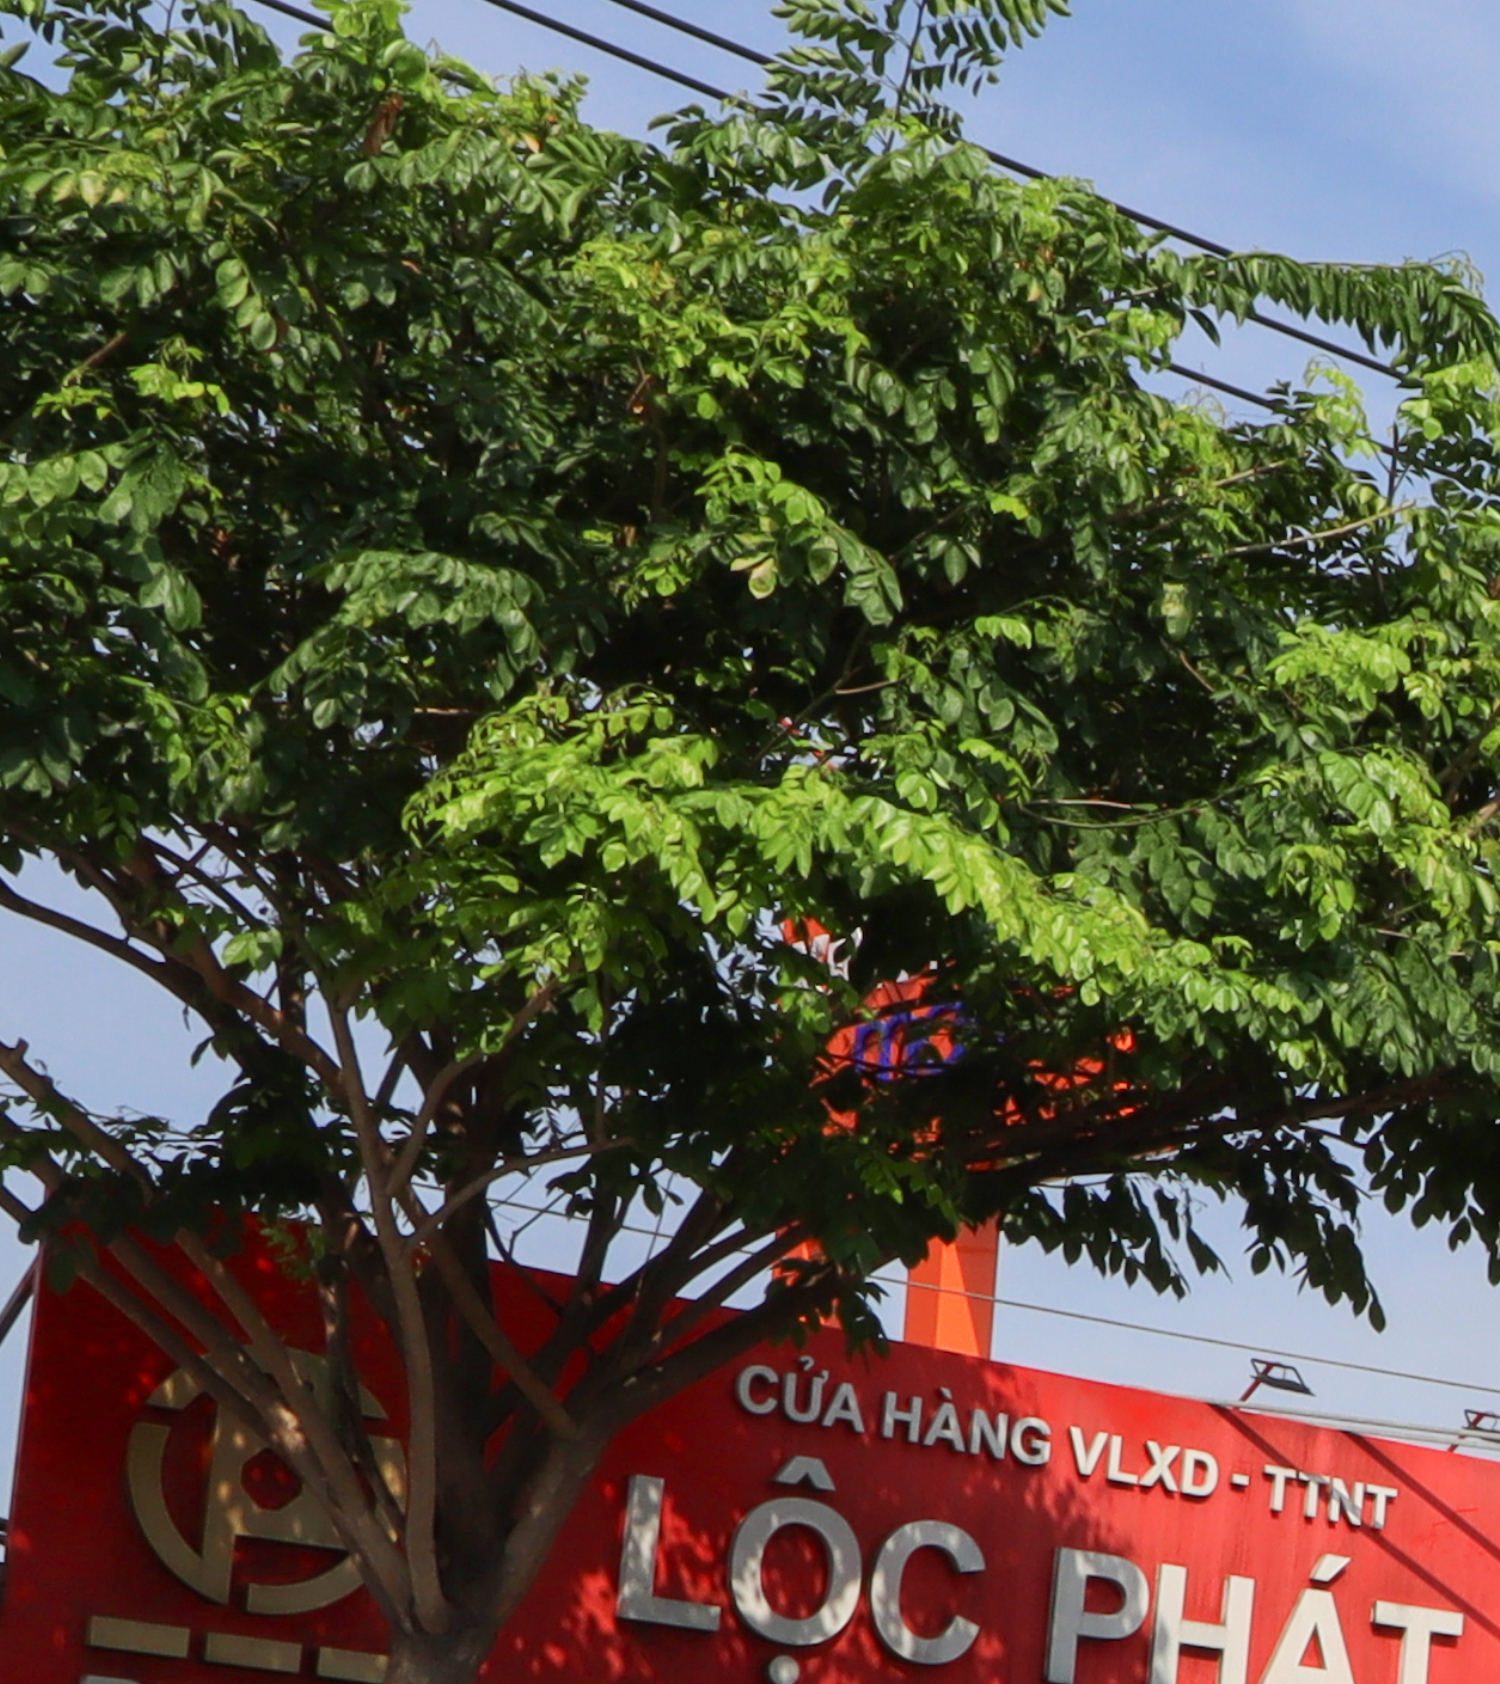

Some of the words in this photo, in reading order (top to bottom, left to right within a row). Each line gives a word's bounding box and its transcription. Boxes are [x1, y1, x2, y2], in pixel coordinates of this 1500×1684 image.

[735, 1356, 864, 1433] CỬA
[882, 1387, 1051, 1465] HÀNG
[1069, 1426, 1218, 1497] VLXD
[1263, 1465, 1397, 1529] TTNT
